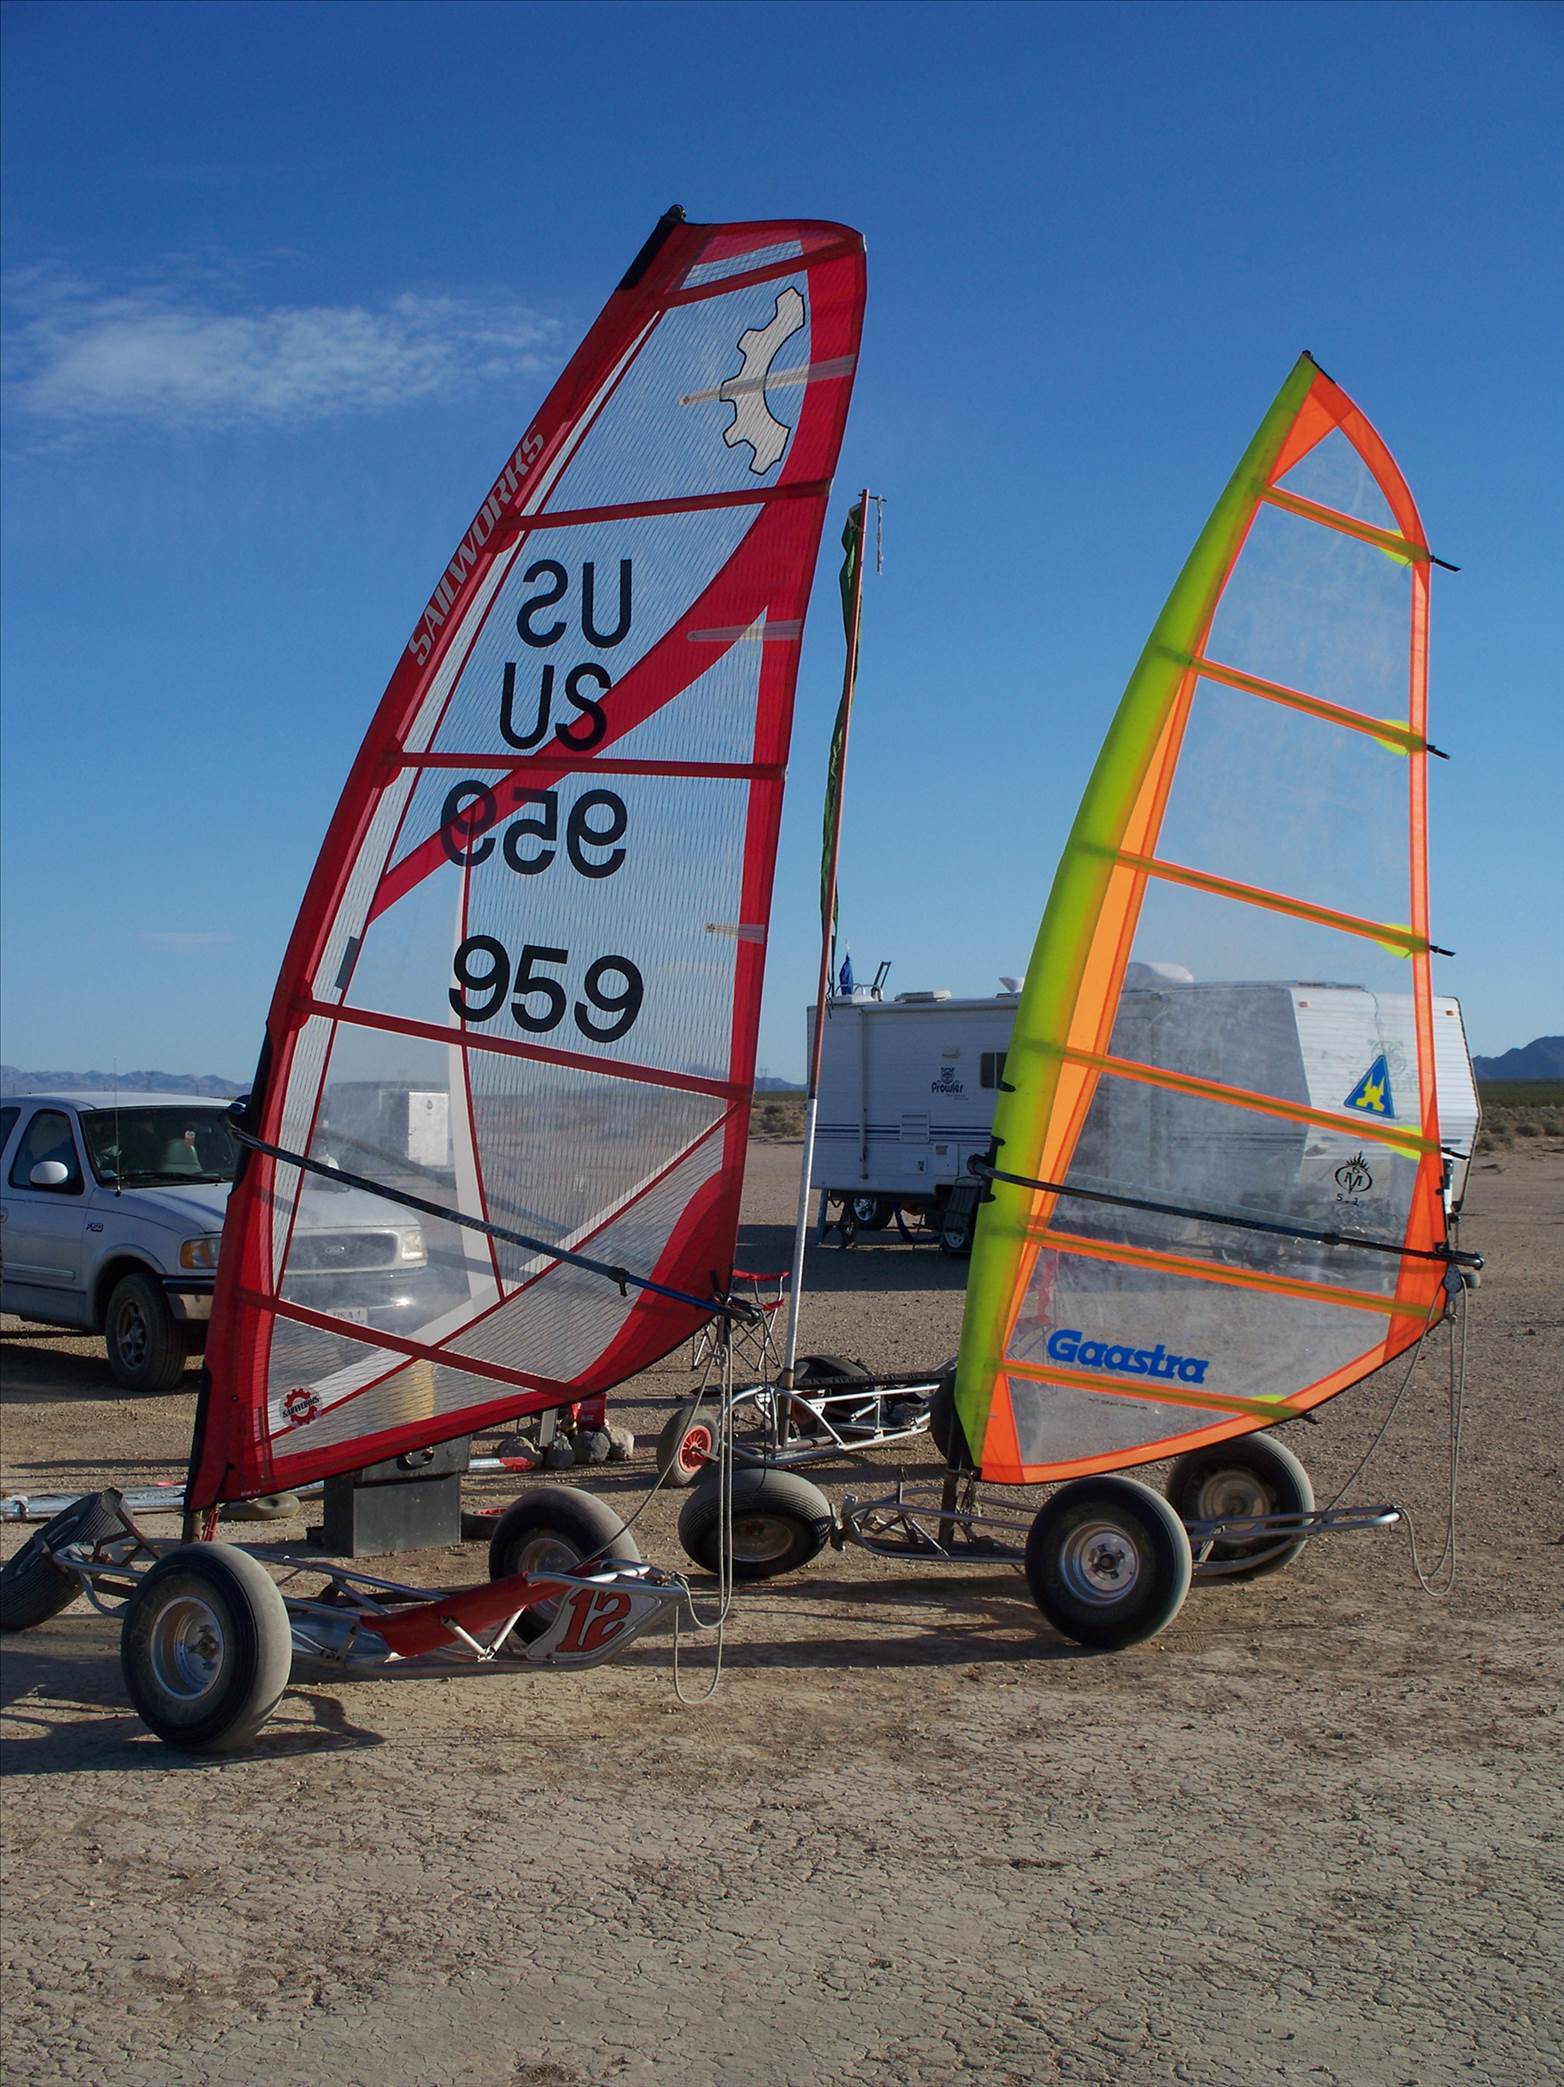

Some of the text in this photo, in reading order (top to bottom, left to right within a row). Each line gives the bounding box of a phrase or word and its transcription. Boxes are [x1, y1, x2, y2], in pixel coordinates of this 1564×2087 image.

[408, 426, 544, 667] SAILWORKS
[499, 662, 613, 752] US
[448, 934, 644, 1044] 959
[931, 1081, 963, 1093] Prowler
[1047, 1328, 1210, 1385] Gaastra
[555, 1589, 631, 1652] 12
